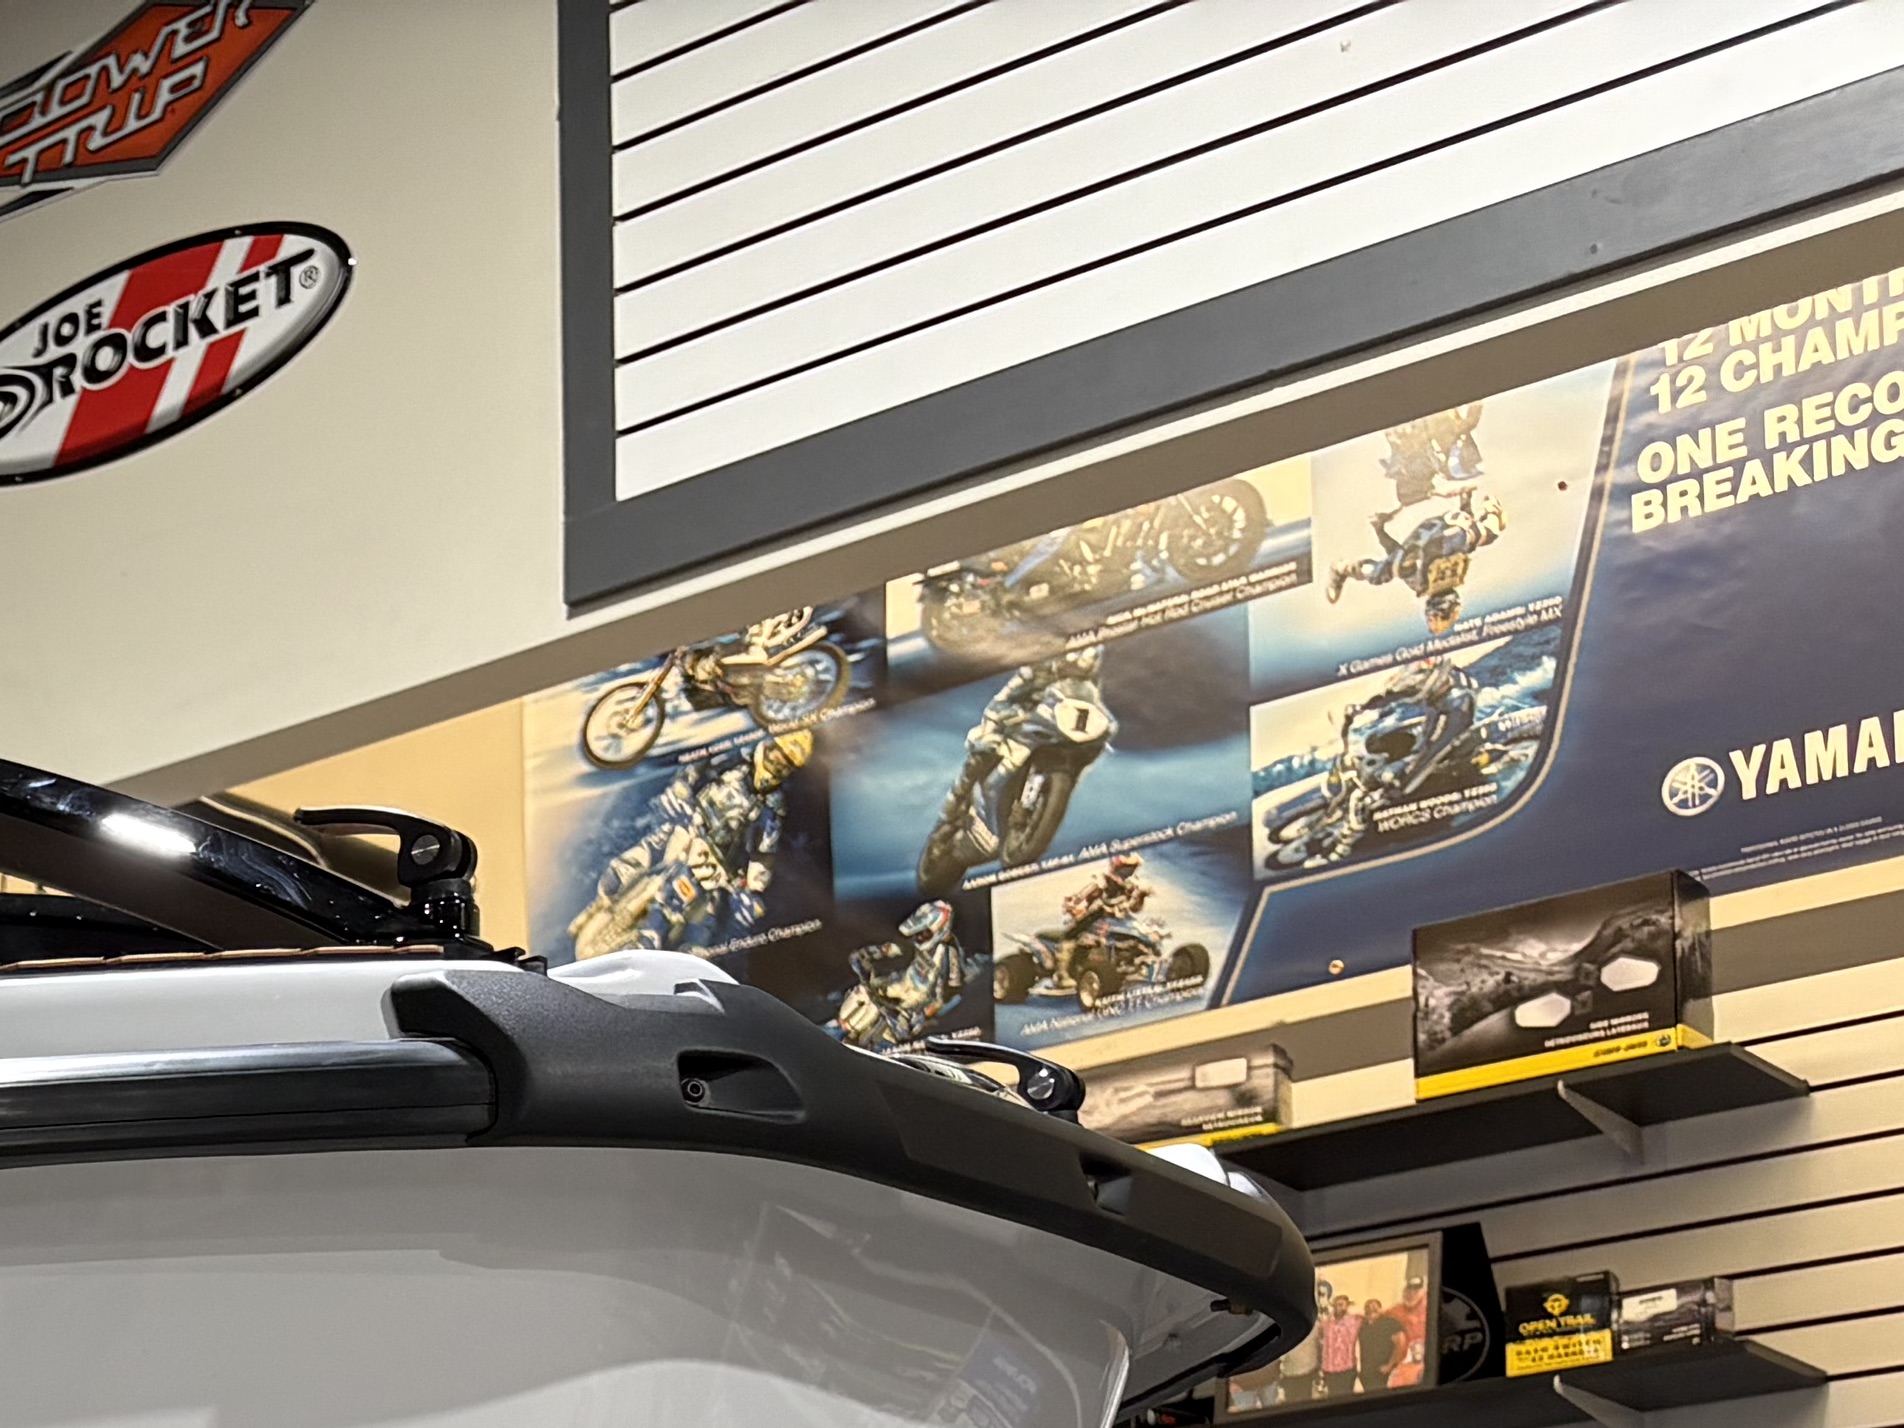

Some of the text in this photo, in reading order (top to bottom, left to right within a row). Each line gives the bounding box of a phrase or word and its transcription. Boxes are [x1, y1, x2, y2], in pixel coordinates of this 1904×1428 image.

[4, 248, 315, 405] ROCKET
[32, 298, 104, 358] JOE
[1637, 371, 1904, 484] ONE RECO
[1650, 365, 1707, 414] 12
[1631, 419, 1904, 533] BREAKING
